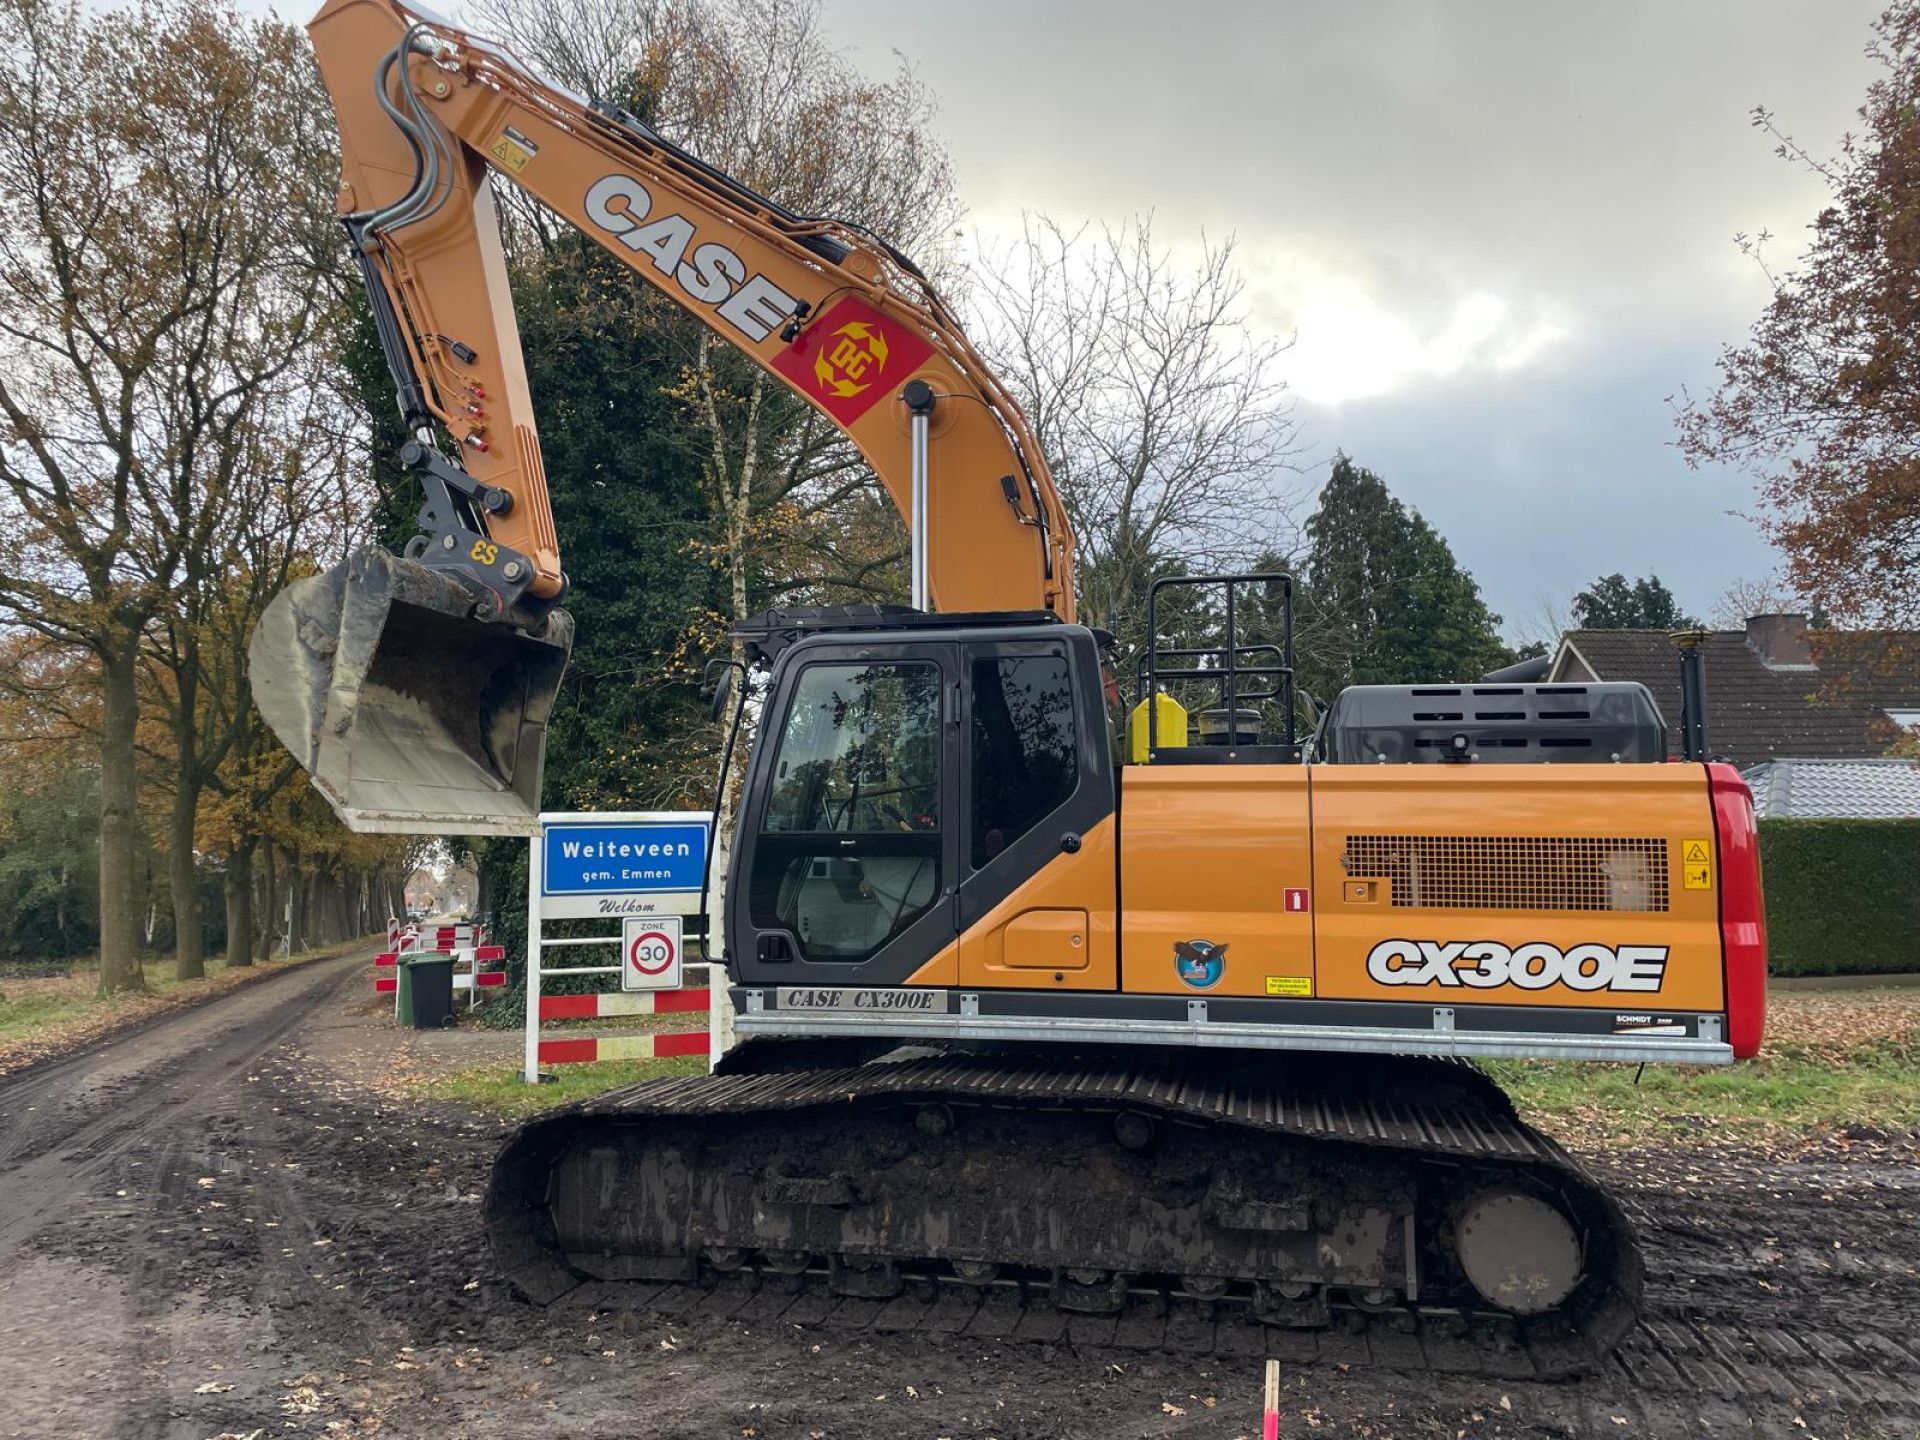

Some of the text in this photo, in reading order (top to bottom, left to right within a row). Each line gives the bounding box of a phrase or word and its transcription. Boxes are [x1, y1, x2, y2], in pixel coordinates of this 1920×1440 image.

[584, 174, 799, 343] CASE
[562, 841, 690, 859] Weiteveen
[582, 869, 671, 883] gem. Emmen
[598, 898, 655, 914] Welkom
[641, 922, 665, 931] ZONE
[640, 945, 666, 962] 30
[1366, 938, 1670, 993] CX300E
[787, 989, 935, 1009] CASE CX300E
[1616, 1015, 1651, 1024] SCHMIDT
